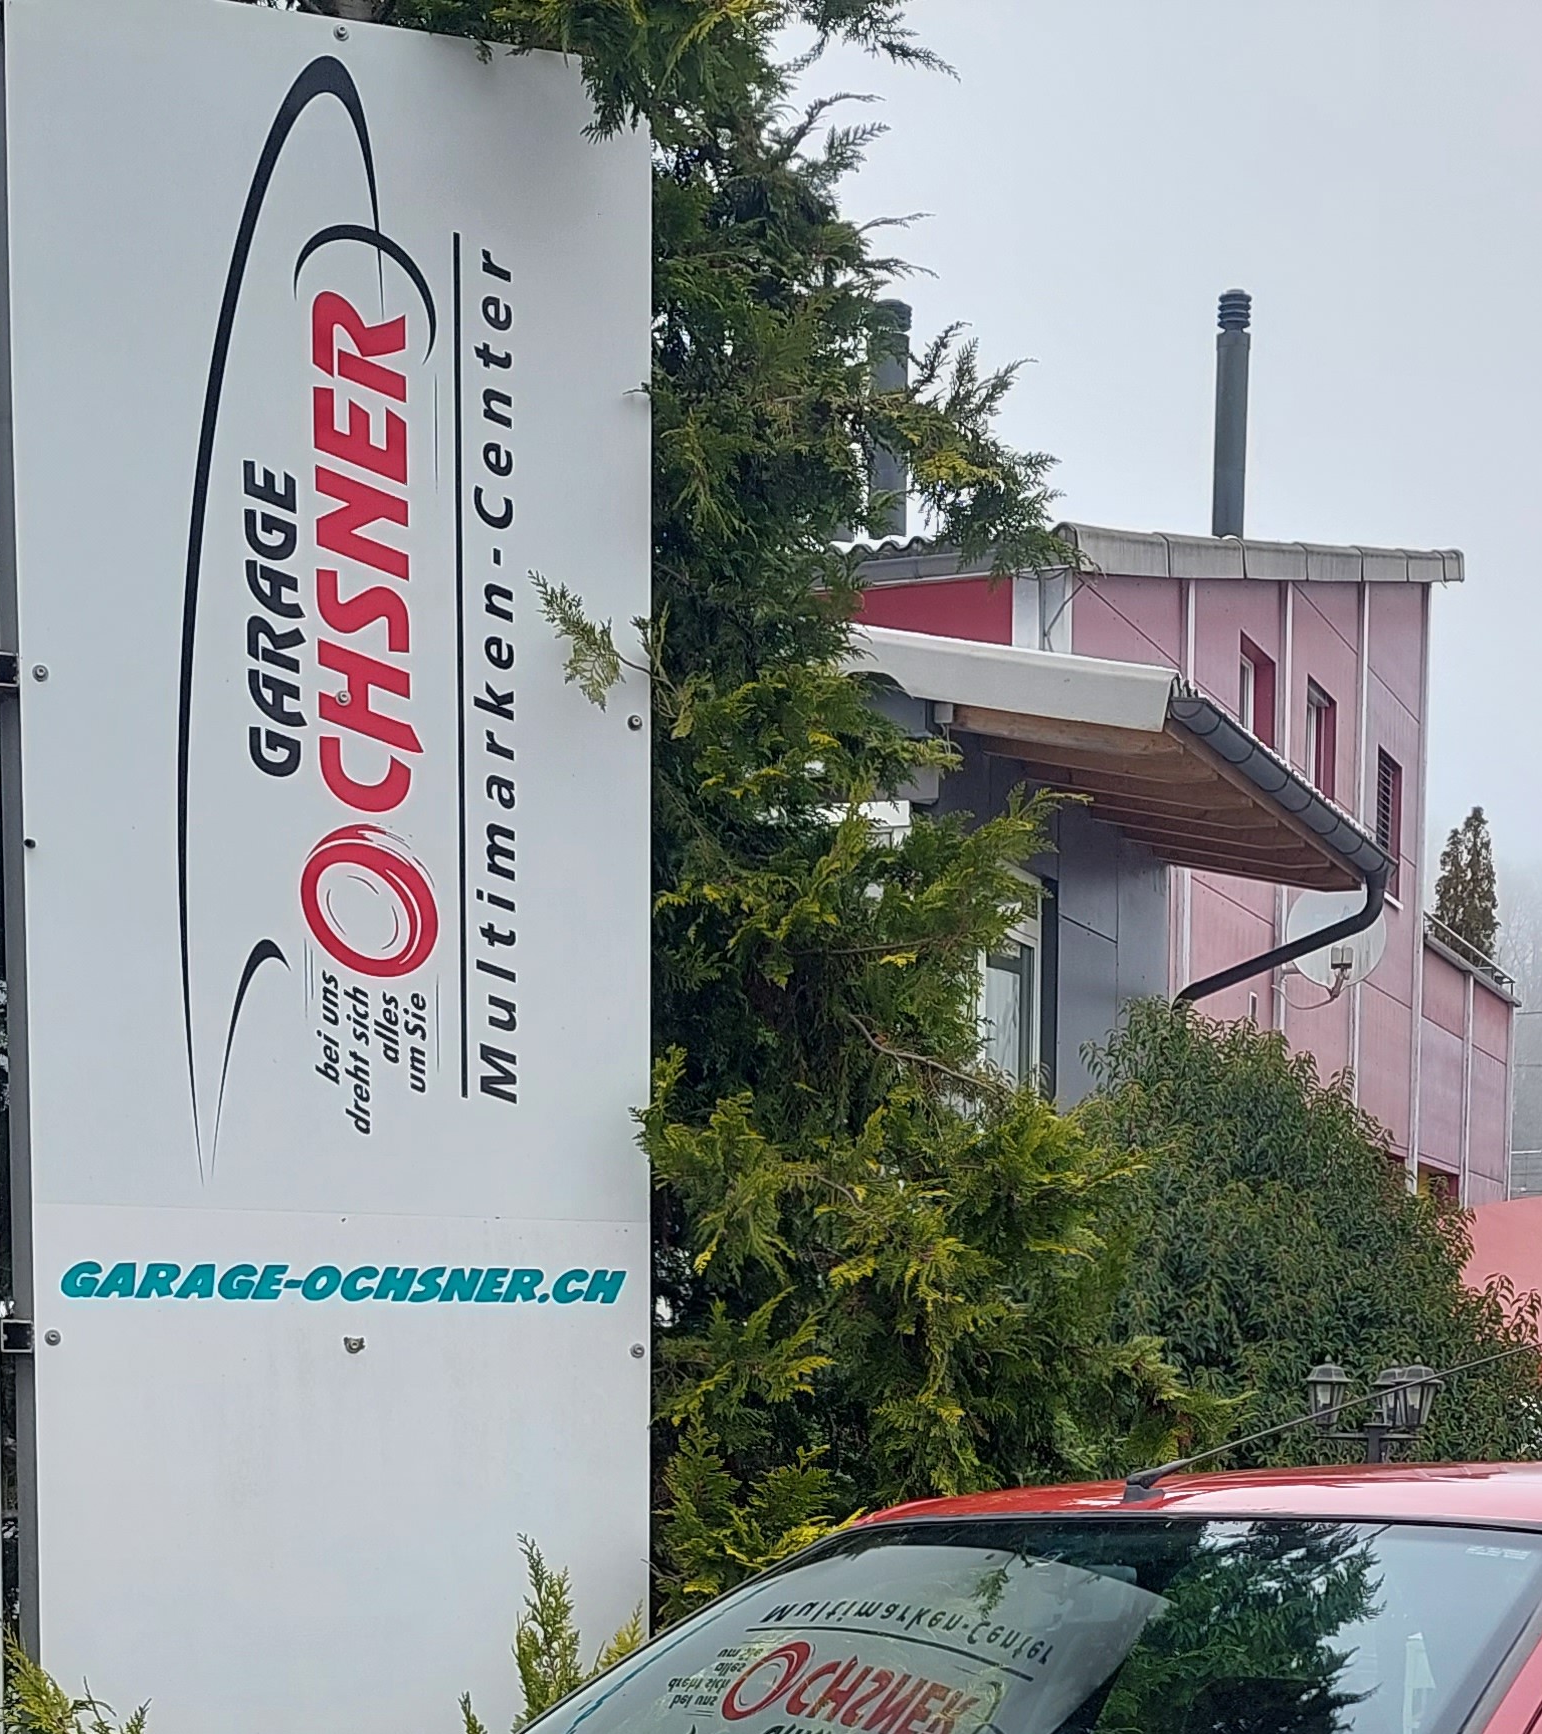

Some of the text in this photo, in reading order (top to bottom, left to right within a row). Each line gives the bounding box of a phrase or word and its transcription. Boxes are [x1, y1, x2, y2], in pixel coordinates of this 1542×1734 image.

[243, 459, 308, 778] GARAGE
[300, 290, 440, 978] OCHSNER
[473, 250, 518, 1105] Multimarken-Center
[315, 969, 340, 1086] bei uns
[343, 985, 371, 1136] dreht sich
[373, 991, 400, 1064] alles
[403, 992, 428, 1094] um Sie
[59, 1260, 628, 1305] GARAGE-OCHSNER.CH
